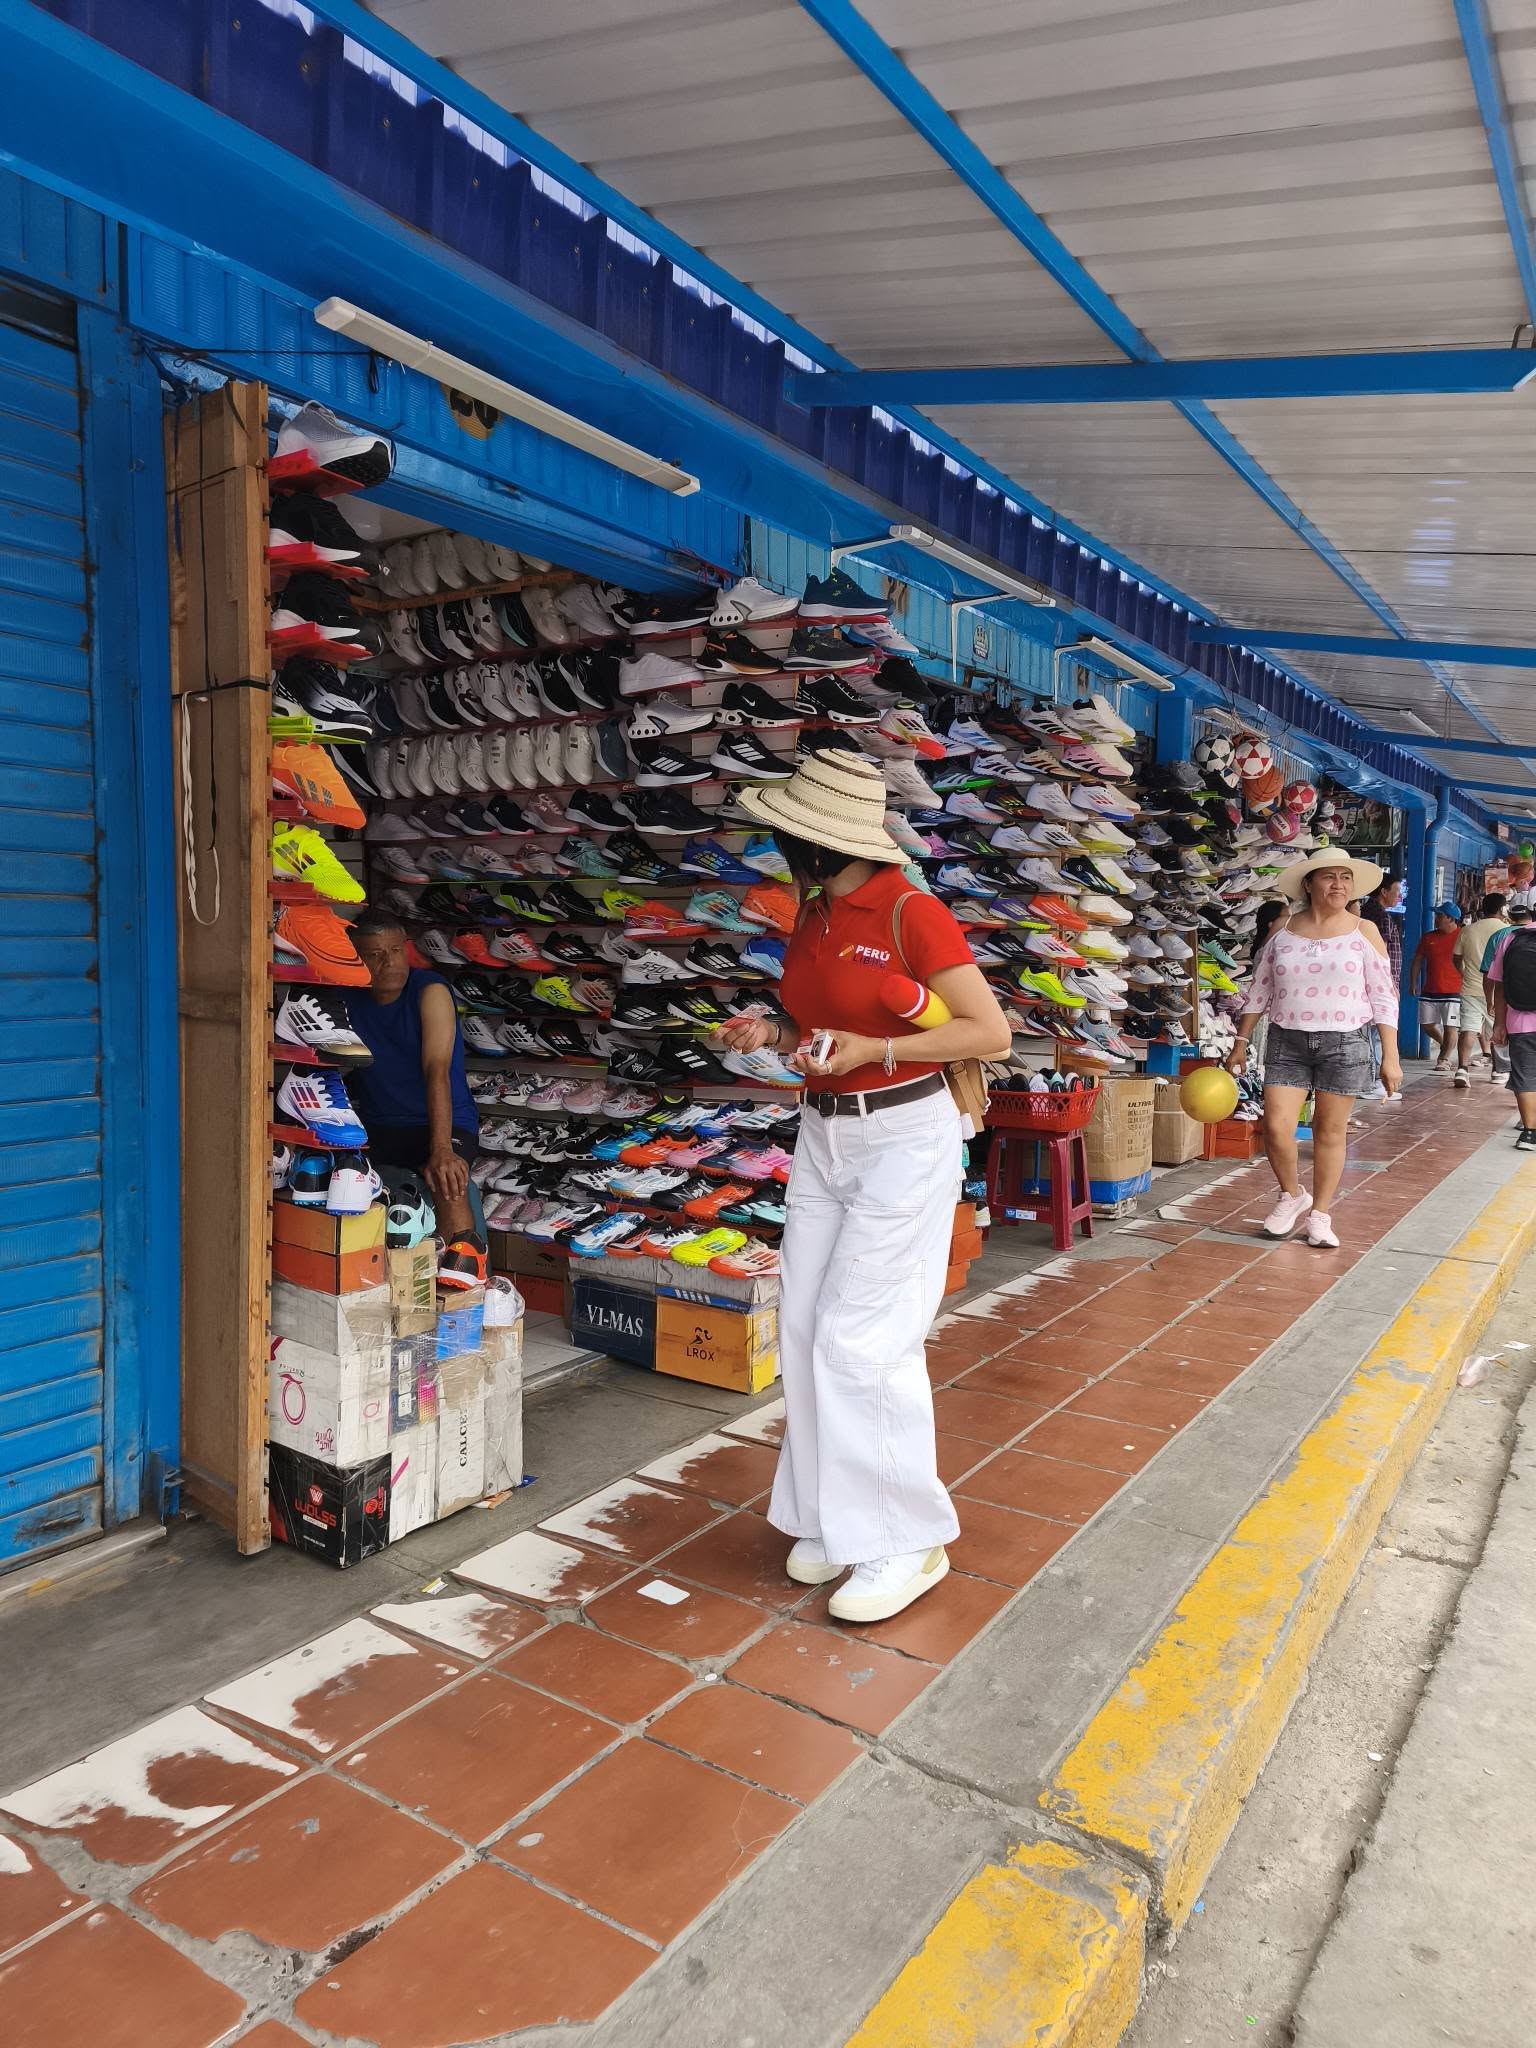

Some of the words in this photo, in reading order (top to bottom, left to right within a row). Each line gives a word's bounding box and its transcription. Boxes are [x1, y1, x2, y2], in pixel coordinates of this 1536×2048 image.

[852, 955, 887, 969] LIBRE
[855, 944, 891, 962] PERÚ
[586, 1304, 644, 1338] VI-MAS
[686, 1346, 715, 1362] LROX
[294, 1497, 338, 1528] WOLSS
